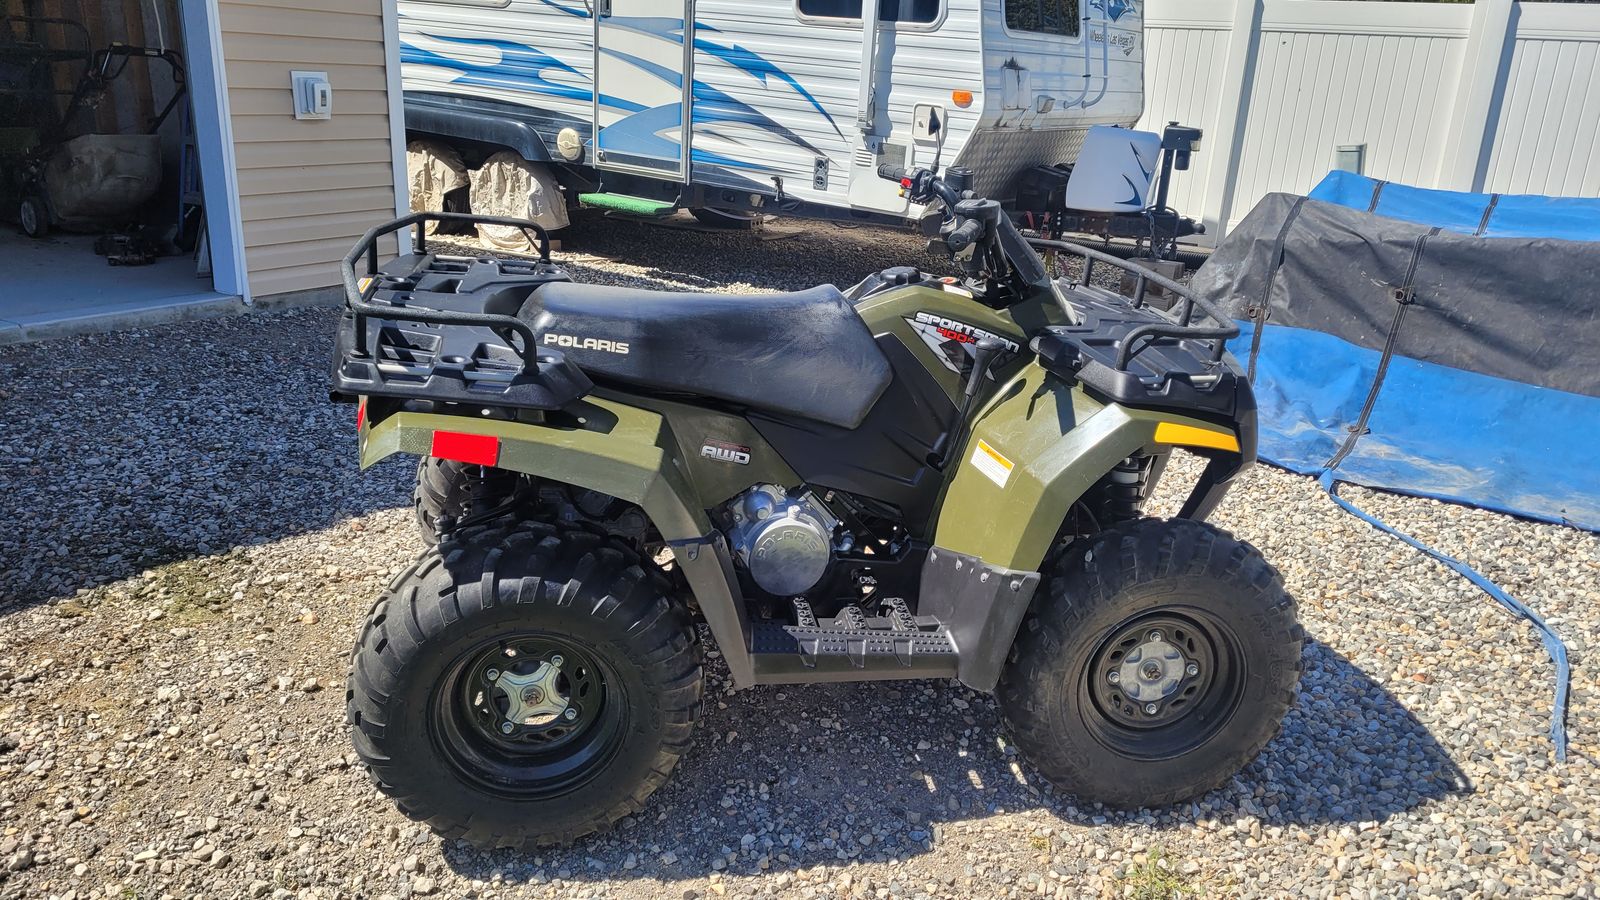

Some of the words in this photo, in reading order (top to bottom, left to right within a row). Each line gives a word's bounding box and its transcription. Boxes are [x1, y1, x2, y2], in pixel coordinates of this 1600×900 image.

[543, 333, 630, 355] POLARIS
[936, 326, 968, 344] 400
[700, 445, 750, 465] AWD
[755, 529, 818, 560] POLARIS
